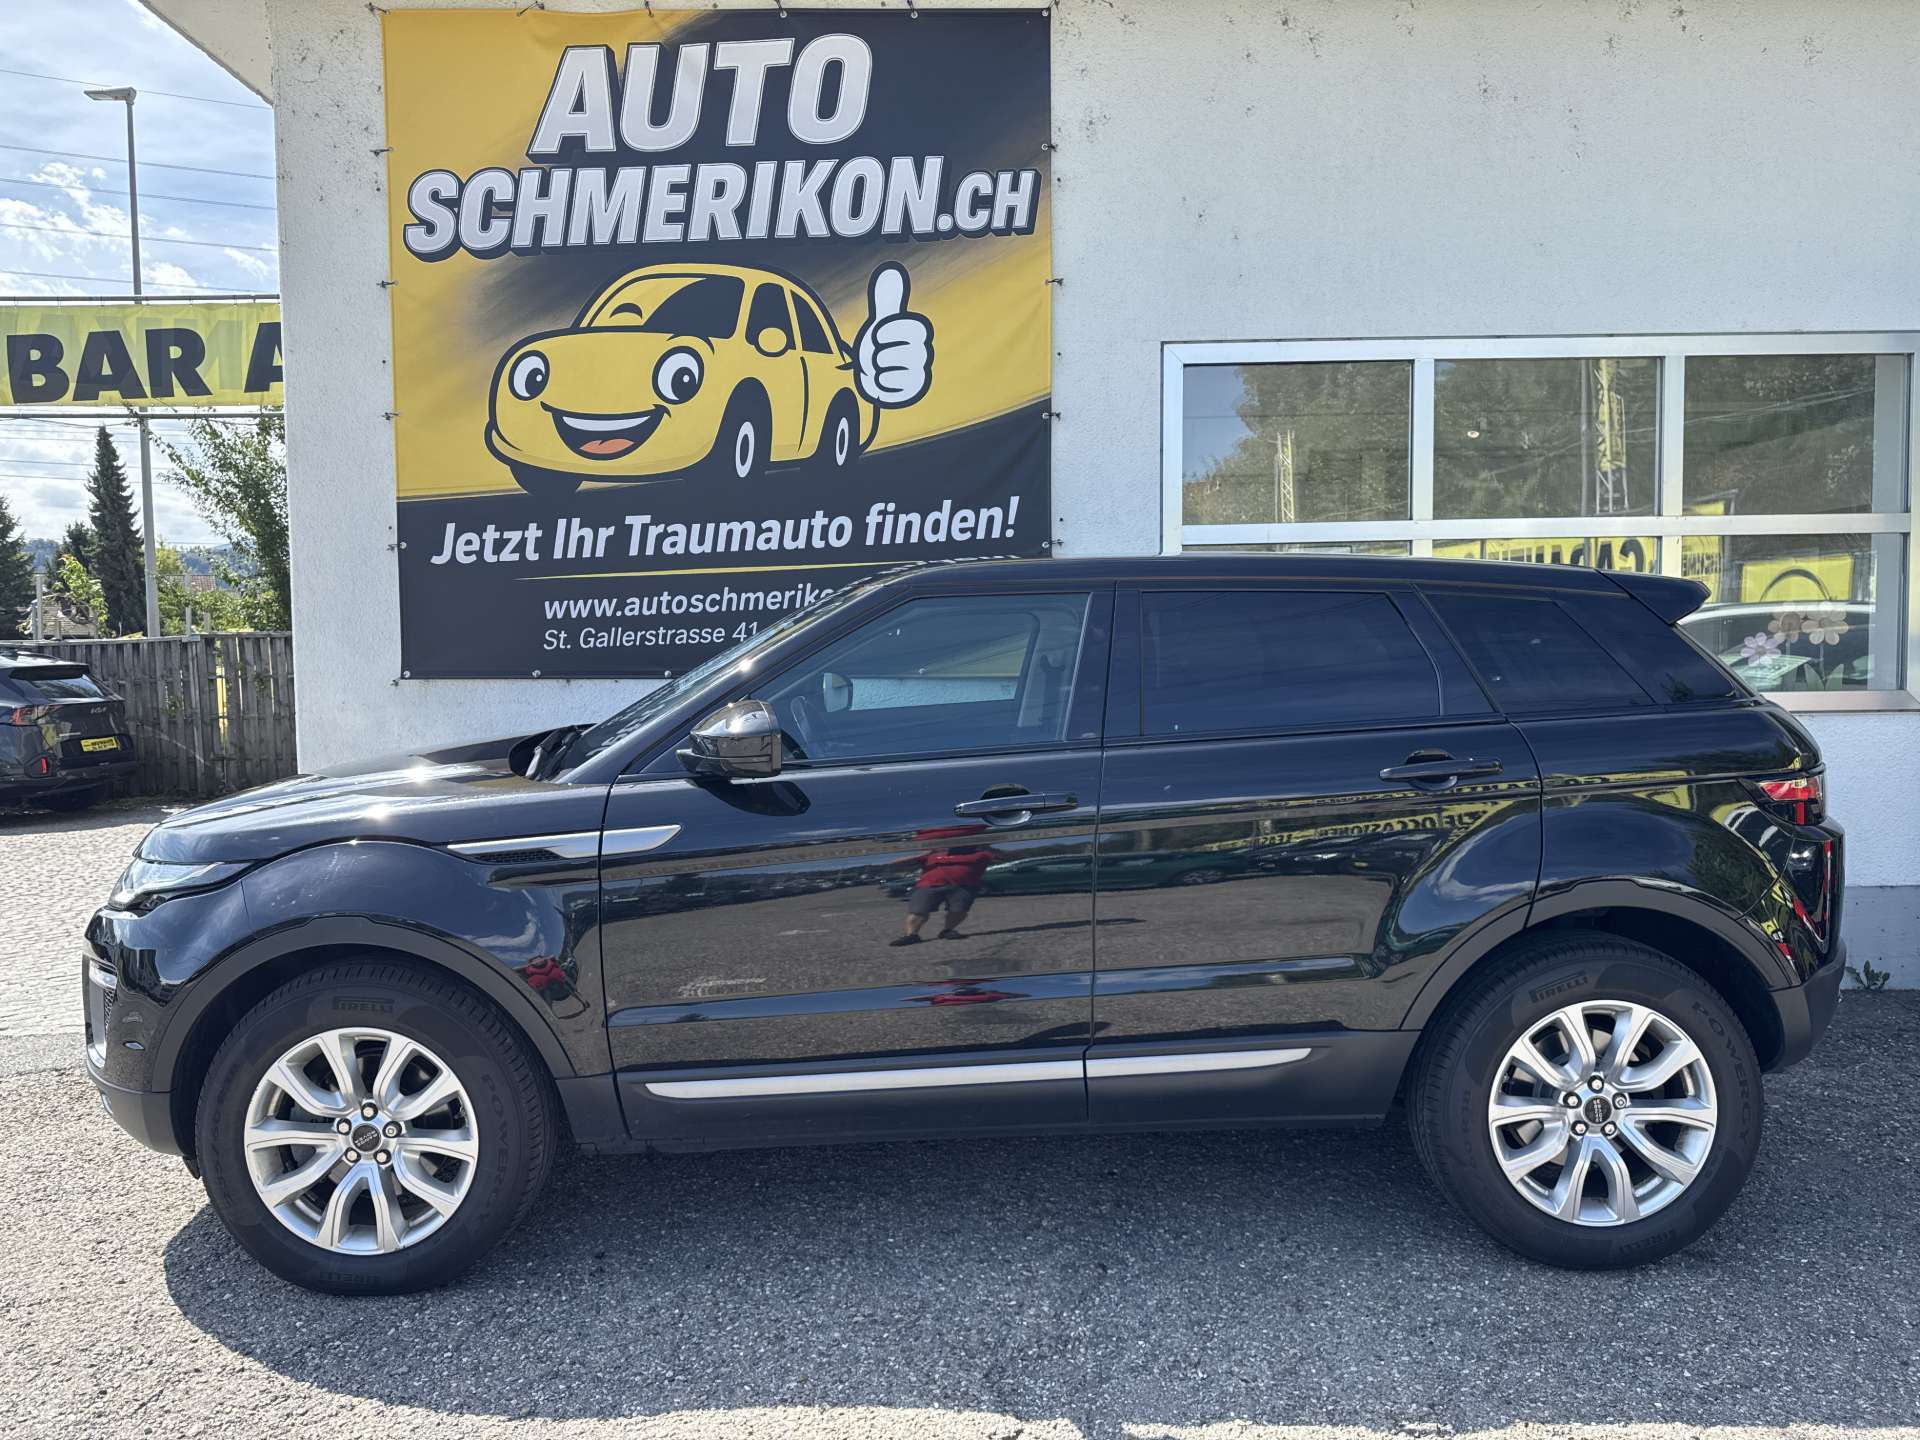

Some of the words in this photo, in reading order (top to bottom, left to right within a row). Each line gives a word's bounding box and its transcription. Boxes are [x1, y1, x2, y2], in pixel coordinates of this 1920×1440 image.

[528, 33, 872, 155] AUTO
[404, 155, 1040, 255] SCHMERIKON.CH
[6, 327, 213, 404] BAR
[430, 522, 543, 565] Jetzt
[553, 517, 615, 560] Ihr
[624, 510, 853, 557] Traumauto
[865, 495, 1020, 546] finden!
[543, 629, 572, 650] St.
[579, 626, 725, 649] Gallerstrasse
